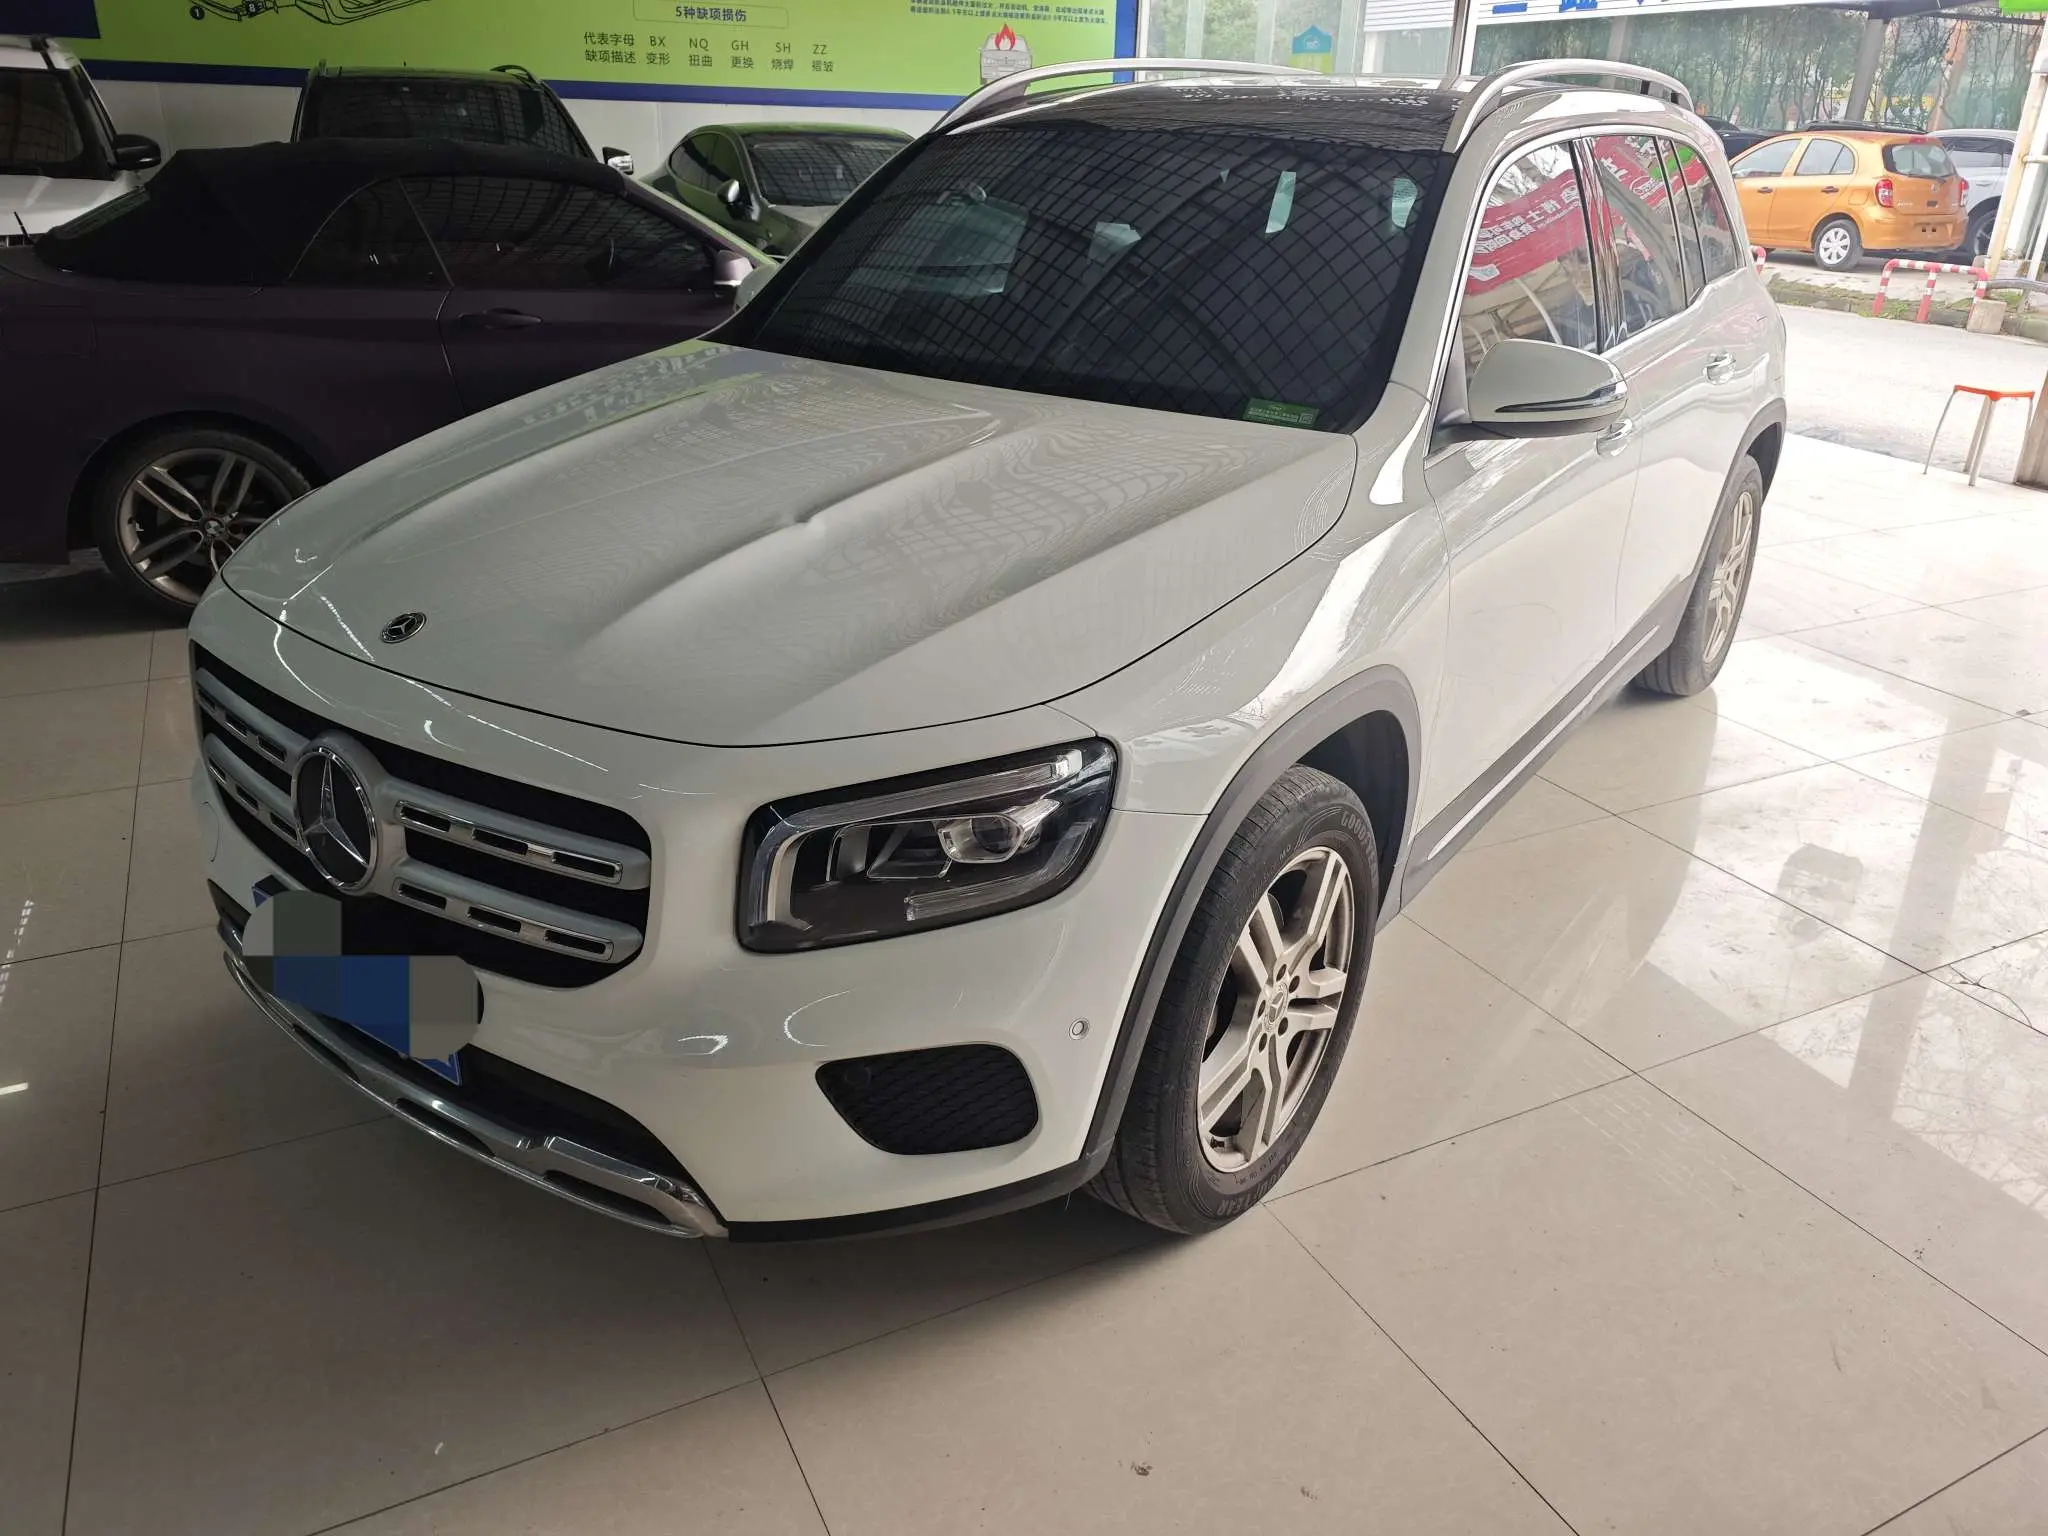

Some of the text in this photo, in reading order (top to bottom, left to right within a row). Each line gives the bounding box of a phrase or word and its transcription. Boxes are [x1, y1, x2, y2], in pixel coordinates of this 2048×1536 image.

[675, 6, 747, 22] 5种缺项损伤
[583, 31, 827, 55] 代表字母 BX NQ GH SH ZZ
[584, 49, 637, 64] 缺项描述
[646, 52, 671, 65] 变形
[688, 54, 713, 68] 扭曲
[730, 56, 754, 69] 更换
